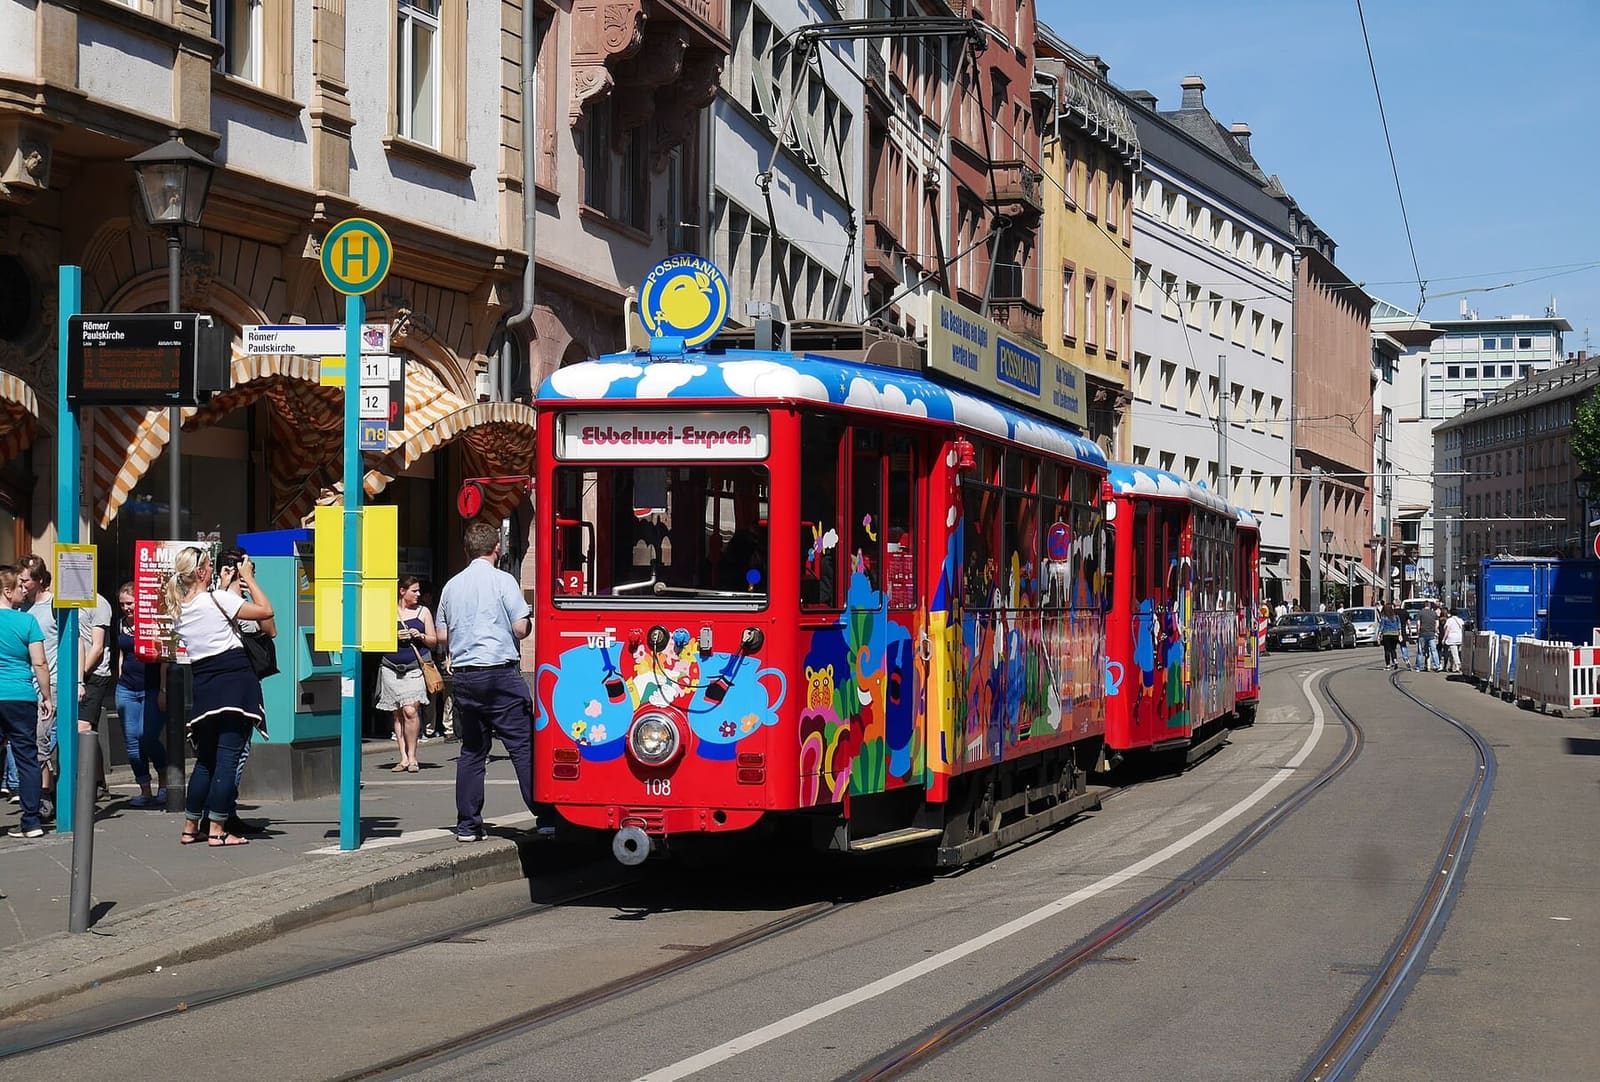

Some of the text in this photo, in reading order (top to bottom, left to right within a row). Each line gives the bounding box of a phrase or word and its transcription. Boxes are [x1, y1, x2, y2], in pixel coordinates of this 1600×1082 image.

[342, 236, 369, 277] H
[647, 256, 720, 283] POSSMANN
[82, 321, 110, 331] Römer/
[82, 331, 125, 340] Paulskirche
[248, 332, 278, 342] Römer/
[248, 343, 296, 353] Paulskirche
[366, 364, 378, 376] 11
[1000, 346, 1038, 389] POSSMANN
[365, 396, 379, 408] 12
[364, 427, 386, 441] n8
[582, 426, 752, 449] Ebbelwei-Expreß
[140, 548, 152, 562] 8.
[570, 576, 578, 588] 2
[587, 627, 616, 648] VGF
[644, 778, 671, 796] 108
